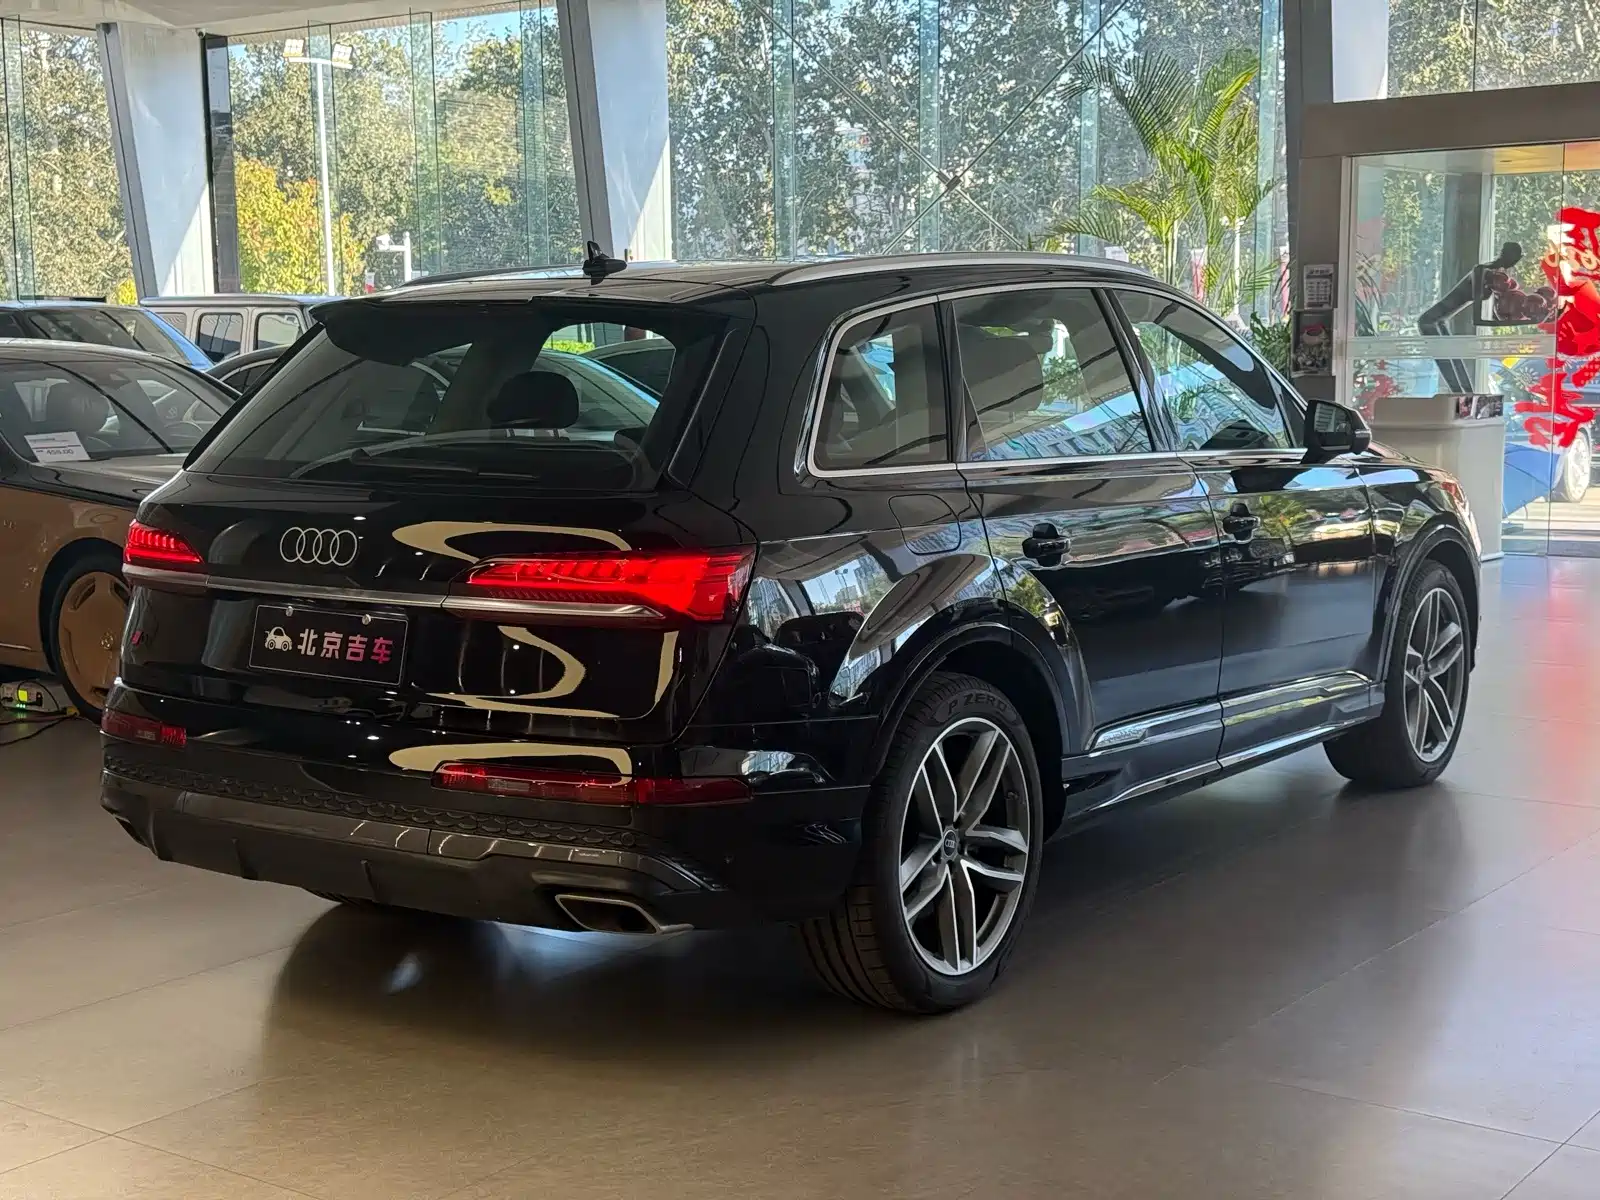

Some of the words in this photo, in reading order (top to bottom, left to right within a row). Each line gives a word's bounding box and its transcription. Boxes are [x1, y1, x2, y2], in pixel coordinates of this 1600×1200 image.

[297, 628, 393, 664] 北京吉车
[948, 700, 958, 715] P
[964, 692, 1008, 713] ZERO
